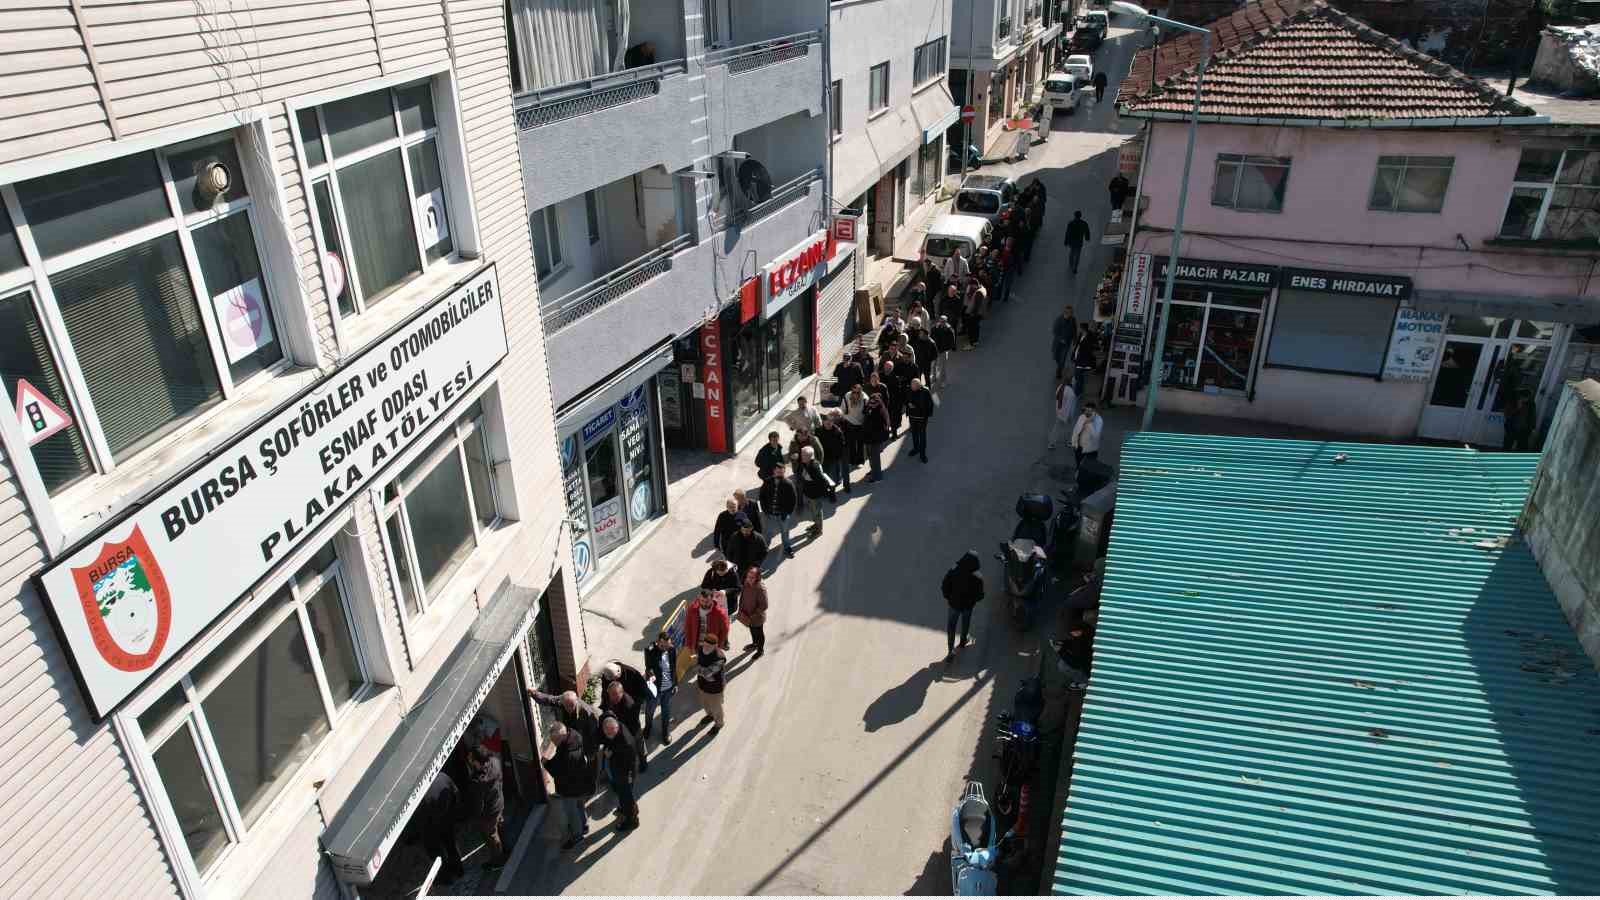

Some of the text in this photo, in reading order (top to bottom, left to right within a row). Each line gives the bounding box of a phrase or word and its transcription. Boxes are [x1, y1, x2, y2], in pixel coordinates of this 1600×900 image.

[1223, 269, 1271, 283] PAZARI
[1291, 276, 1404, 295] ENES HIRDAVAT
[161, 280, 493, 542] BURSA ŞOFÖRLER ve OTOMOBİLCİLER
[318, 369, 429, 475] ESNAF ODASI
[260, 361, 474, 562] PLAKA ATÖLYESİ
[88, 545, 135, 583] BURSA
